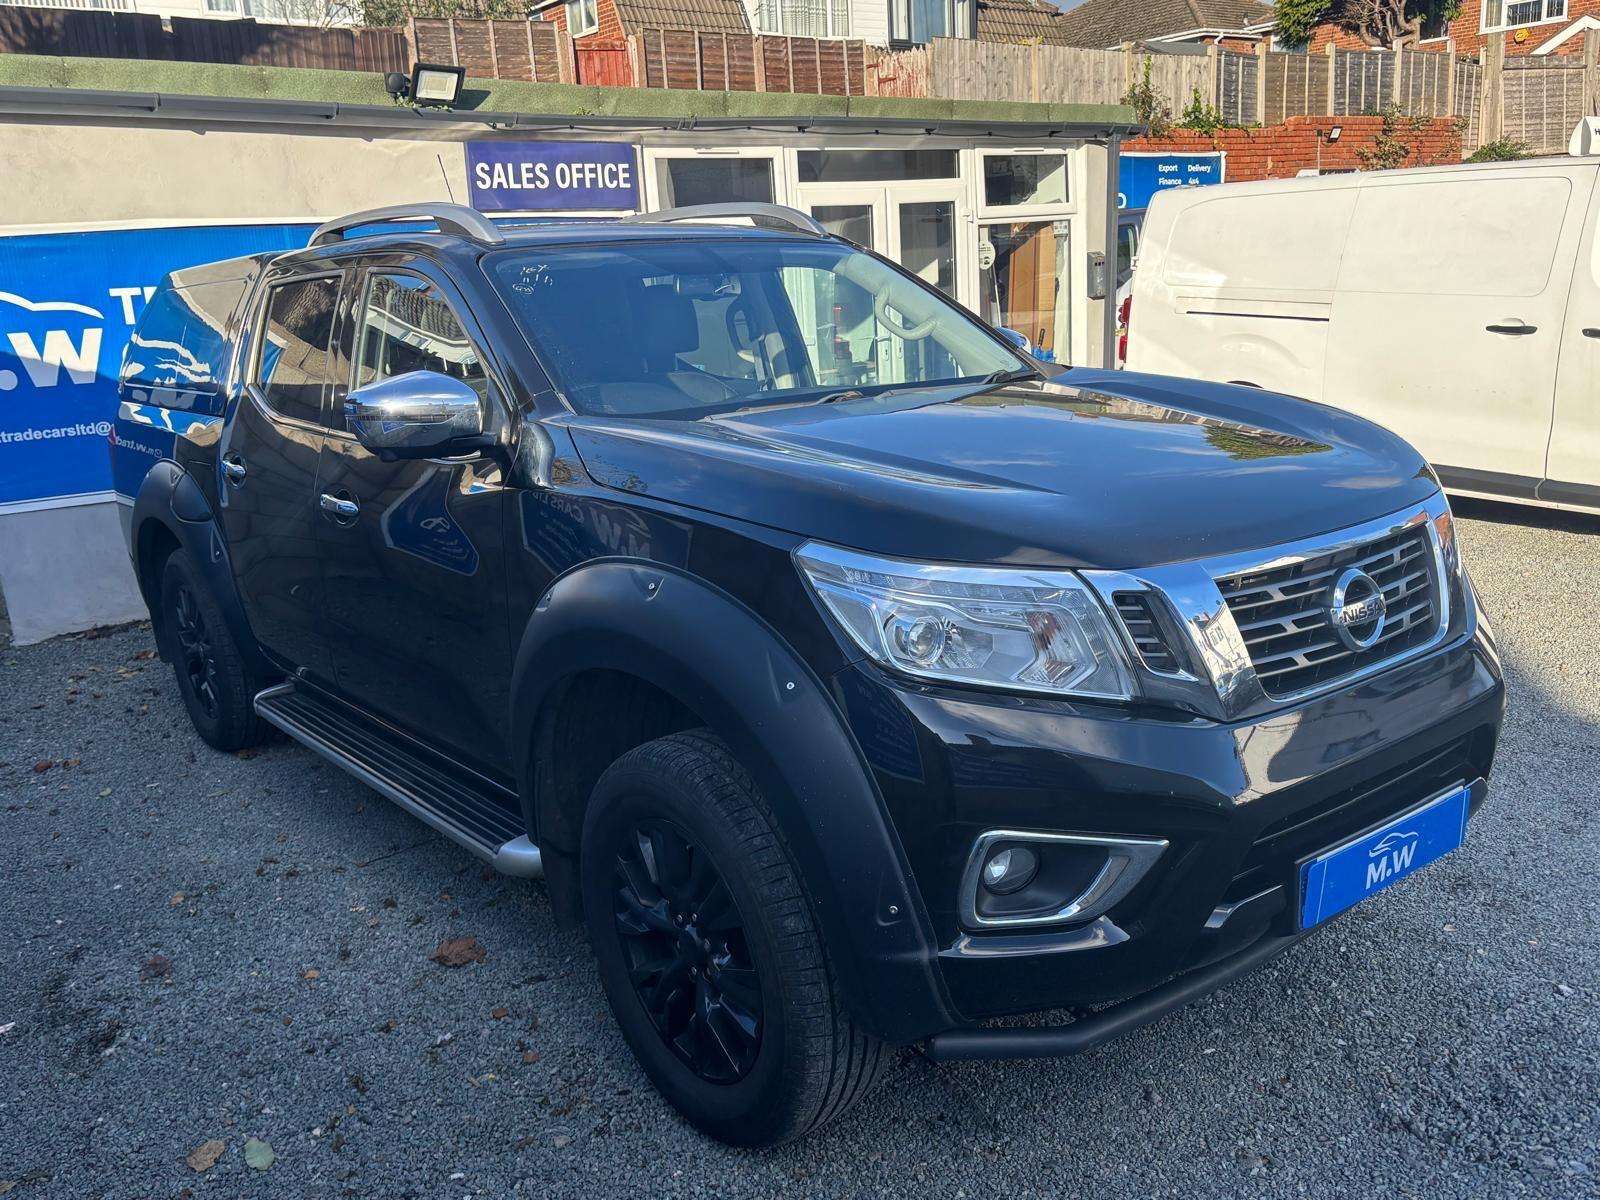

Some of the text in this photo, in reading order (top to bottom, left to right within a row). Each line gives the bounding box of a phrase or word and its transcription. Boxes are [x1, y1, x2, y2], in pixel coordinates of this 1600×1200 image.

[475, 162, 631, 190] SALES OFFICE
[1158, 164, 1211, 173] Export Delivery
[1158, 177, 1182, 185] Finance
[109, 286, 157, 325] T
[1366, 840, 1418, 890] M.W
